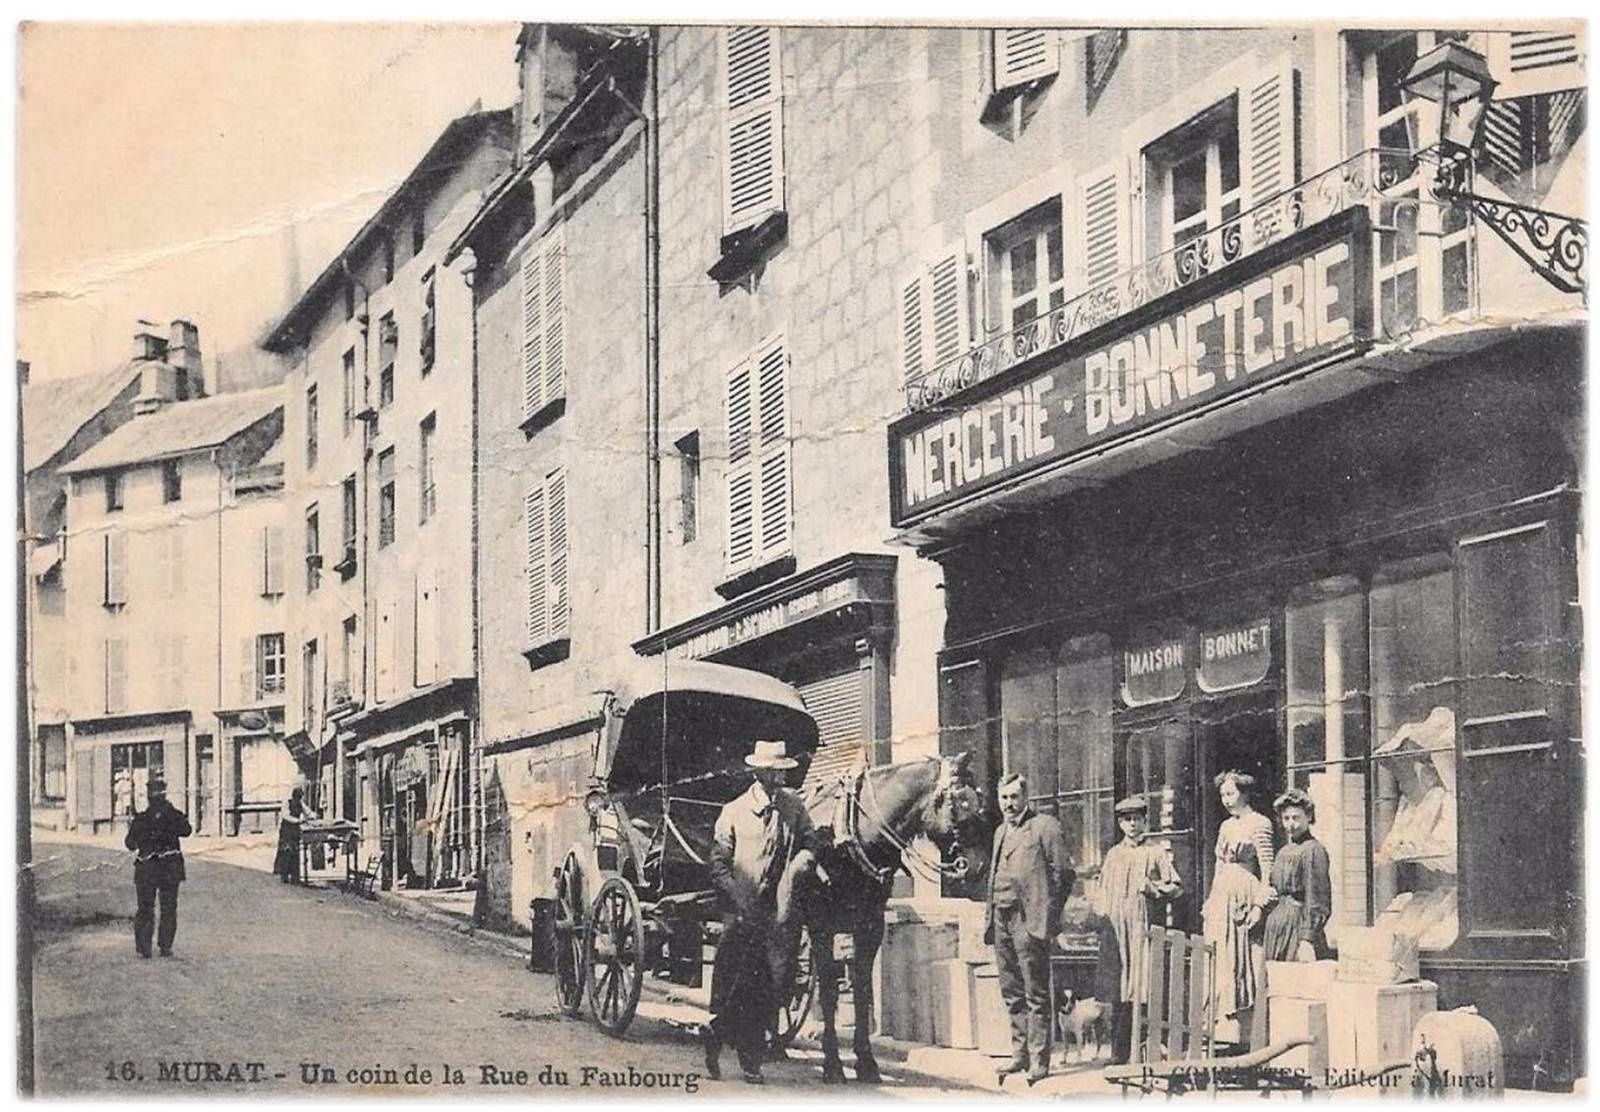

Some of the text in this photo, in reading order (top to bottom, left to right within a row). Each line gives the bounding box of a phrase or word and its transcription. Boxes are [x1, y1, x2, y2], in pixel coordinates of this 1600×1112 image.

[905, 242, 1350, 506] MERCERIE BONNETERIE
[1130, 624, 1269, 676] MAISON BONNET
